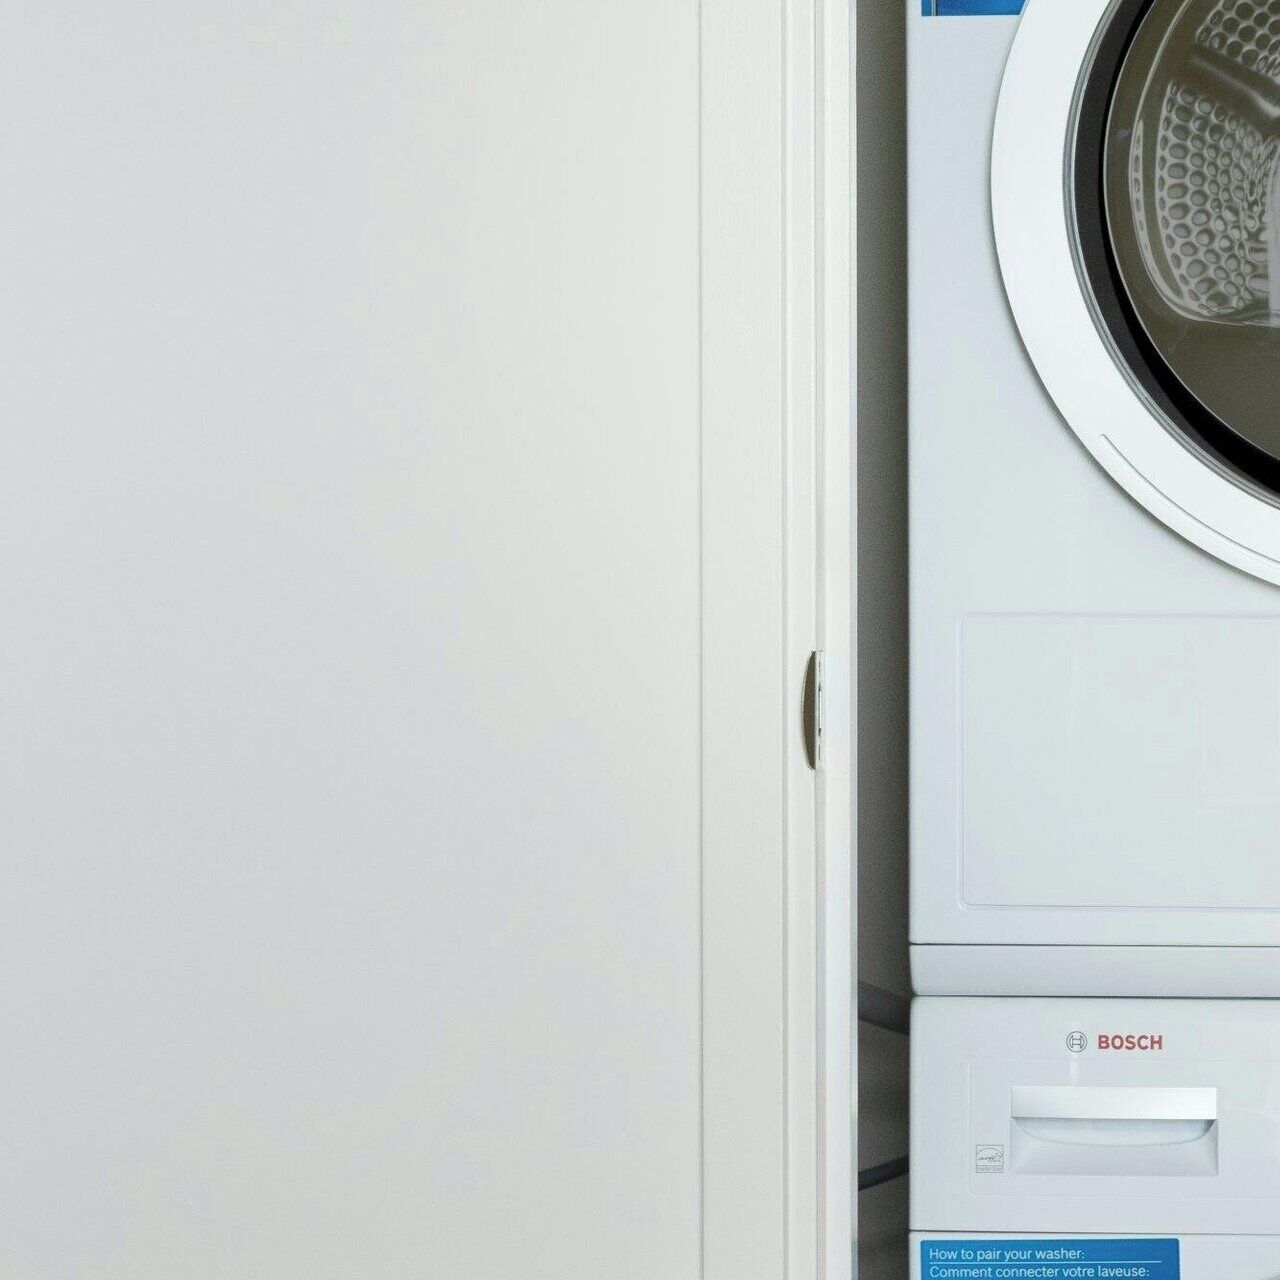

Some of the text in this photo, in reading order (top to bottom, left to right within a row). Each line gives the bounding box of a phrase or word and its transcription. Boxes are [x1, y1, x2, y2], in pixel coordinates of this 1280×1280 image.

[1098, 1035, 1163, 1050] BOSCH
[929, 1247, 1085, 1261] How to pair your washer:
[929, 1265, 1150, 1277] Comment connecter votre laveuse:
